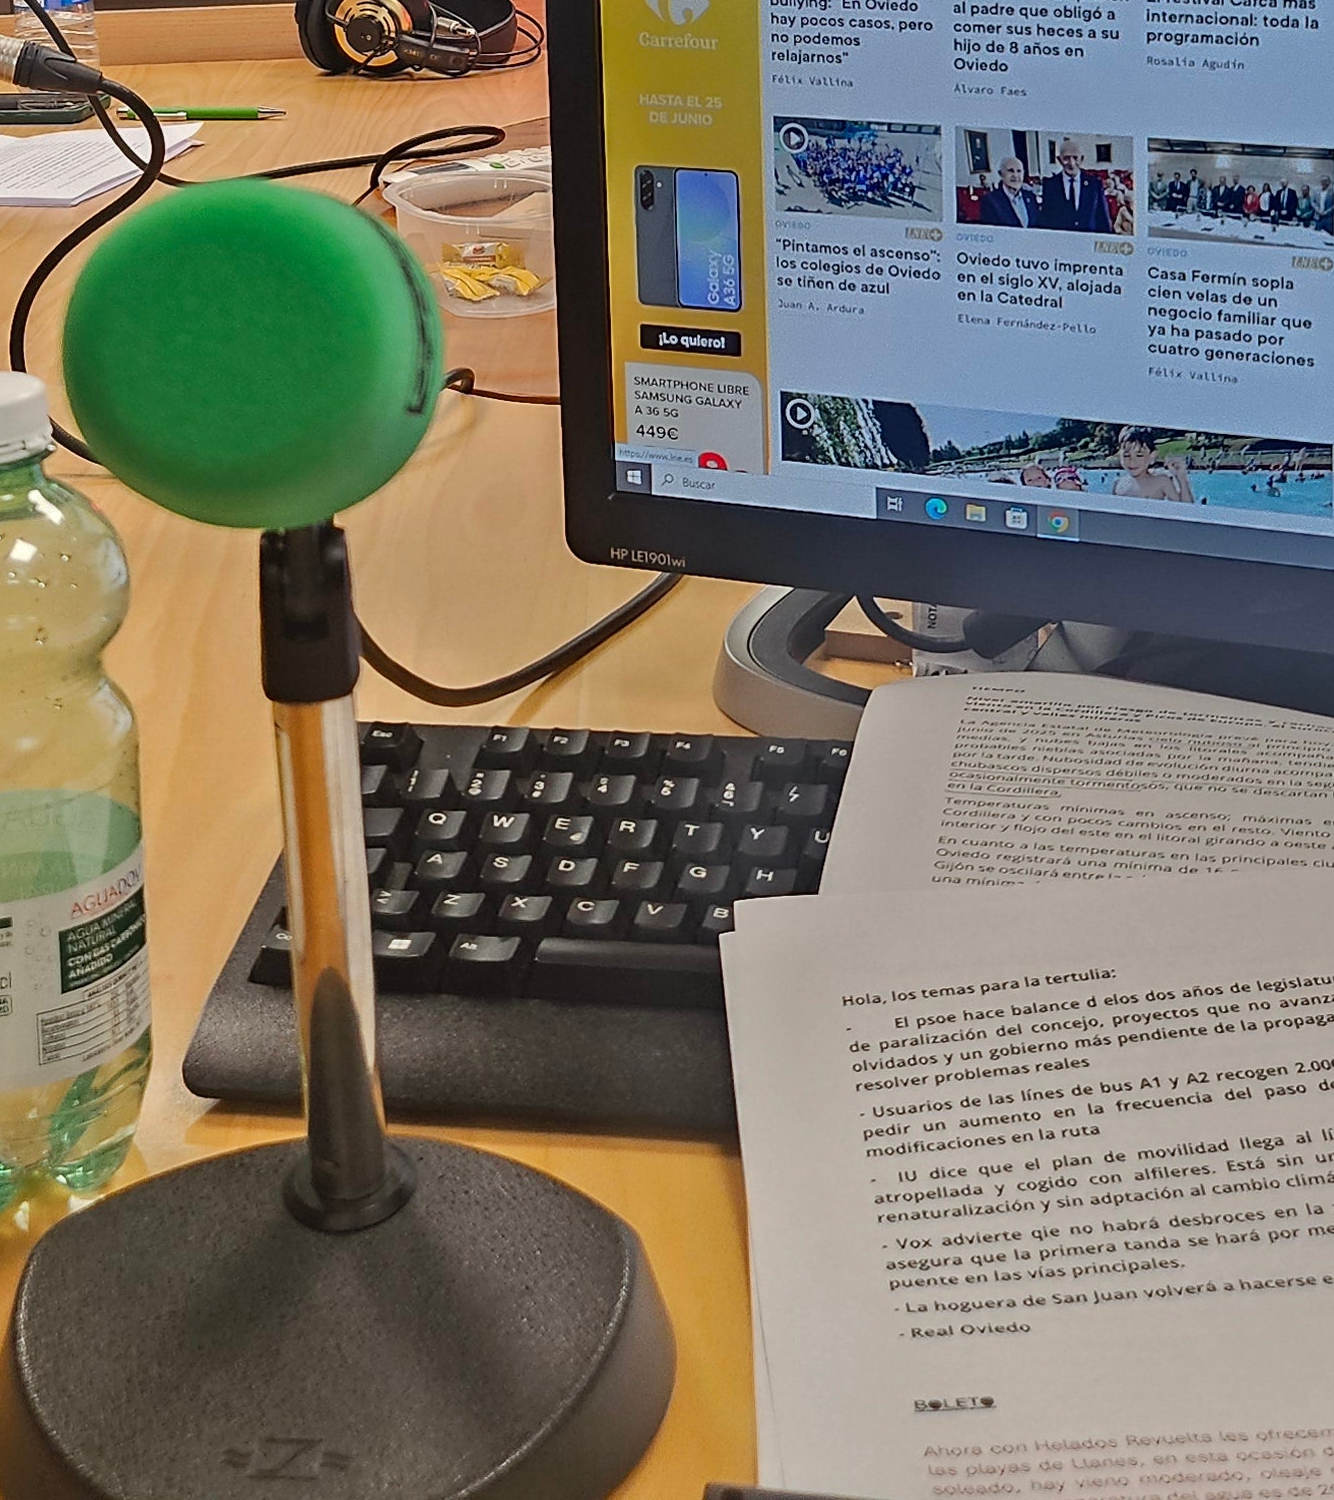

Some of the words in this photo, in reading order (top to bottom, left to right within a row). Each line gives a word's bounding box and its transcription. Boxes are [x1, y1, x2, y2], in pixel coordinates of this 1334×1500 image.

[953, 0, 966, 14] al
[970, 1, 1015, 17] padre
[1018, 6, 1048, 19] que
[1053, 5, 1102, 22] obligó
[1106, 10, 1115, 20] a
[1146, 8, 1257, 26] internacional:
[1262, 14, 1299, 28] toda
[1305, 15, 1319, 29] la
[770, 11, 796, 28] hay
[800, 16, 844, 28] pocos
[848, 18, 895, 30] casos,
[898, 20, 933, 33] pero
[953, 22, 1002, 34] comer
[1006, 25, 1032, 35] sus
[1036, 23, 1083, 38] heces
[1087, 28, 1096, 38] a
[1101, 29, 1119, 39] su
[638, 31, 718, 50] Carrefour
[771, 33, 789, 43] no
[793, 31, 860, 46] podemos
[953, 37, 981, 55] hijo
[985, 39, 1005, 53] de
[1009, 41, 1019, 54] 8
[1023, 41, 1060, 56] años
[1064, 46, 1084, 57] en
[1146, 31, 1259, 46] programación
[771, 48, 848, 65] relajarnos"
[953, 57, 1008, 72] Oviedo
[772, 74, 803, 85] Félix
[808, 76, 853, 87] Vallina
[707, 250, 721, 304] Galaxy
[633, 376, 714, 393] SMARTPHONE
[717, 383, 749, 396] LIBRE
[634, 390, 692, 404] SAMSUNG
[695, 396, 742, 409] GALAXY
[634, 404, 643, 414] A
[645, 405, 659, 416] 36
[663, 407, 679, 418] 5G
[636, 424, 678, 440] 449€
[682, 476, 715, 490] Buscar
[610, 546, 628, 560] HP
[631, 549, 685, 567] LE1901wi
[428, 812, 447, 826] Q
[493, 815, 515, 828] W
[555, 818, 571, 830] E
[619, 821, 636, 833] R
[684, 824, 700, 837] T
[750, 827, 765, 840] Y
[841, 993, 886, 1006] Hola,
[891, 990, 917, 1002] los
[920, 985, 975, 998] temas
[979, 980, 1020, 995] para
[1024, 976, 1040, 987] la
[1044, 968, 1116, 985] tertulia:
[894, 1015, 909, 1028] El
[916, 1013, 956, 1029] psoe
[962, 1008, 1005, 1021] hace
[1010, 1000, 1080, 1016] balance
[1086, 995, 1097, 1008] d
[1103, 993, 1139, 1006] elos
[1145, 989, 1176, 1002] dos
[1182, 985, 1224, 998] años
[1229, 982, 1251, 993] de
[855, 1075, 929, 1092] resolver
[934, 1064, 1030, 1086] problemas
[1035, 1057, 1090, 1072] reales
[866, 1135, 1006, 1157] modificaciones
[1011, 1132, 1034, 1143] en
[1038, 1128, 1056, 1140] la
[1061, 1125, 1100, 1138] ruta
[911, 1325, 953, 1337] Real
[960, 1322, 1030, 1335] Oviedo
